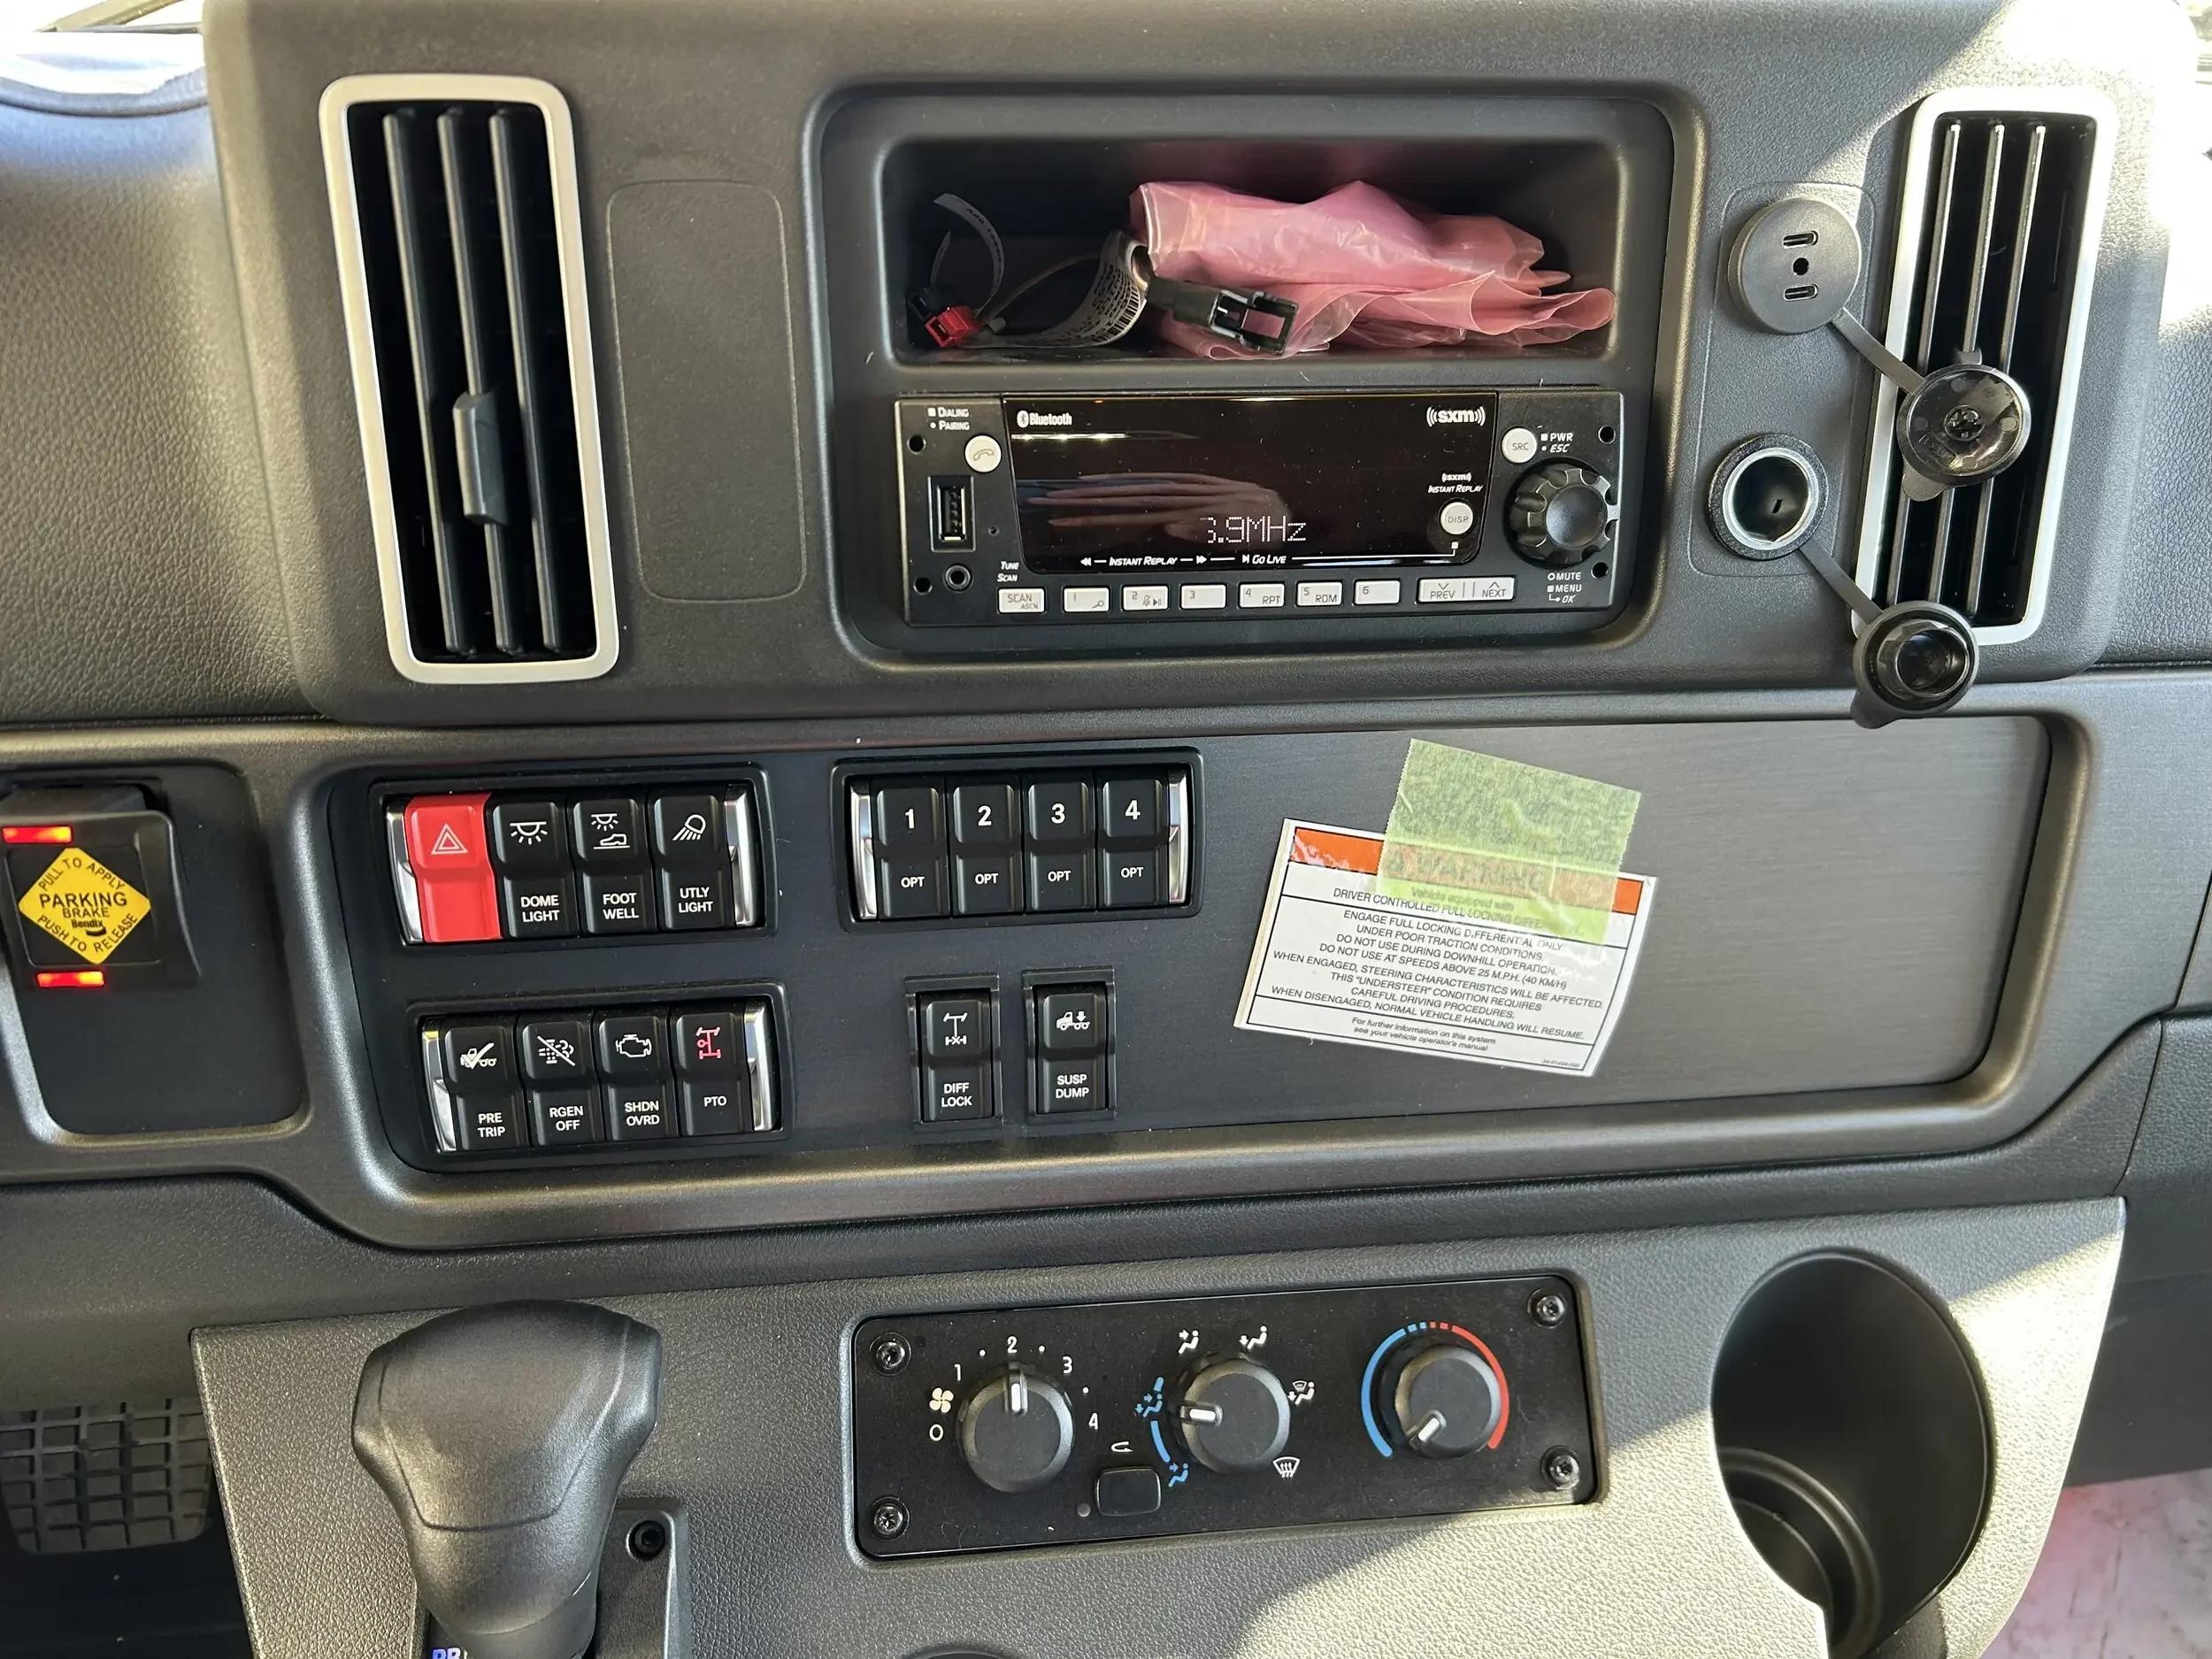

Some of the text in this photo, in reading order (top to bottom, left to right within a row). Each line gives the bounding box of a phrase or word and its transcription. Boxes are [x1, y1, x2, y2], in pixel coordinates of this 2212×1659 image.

[1029, 412, 1072, 426] Bluetooth
[1550, 433, 1573, 442] PWR
[1512, 442, 1528, 451] SRC
[1549, 443, 1569, 453] ESC
[1448, 514, 1469, 525] DISP
[996, 573, 1018, 583] SCAN
[1556, 572, 1581, 581] MUTE
[1189, 590, 1196, 600] 3
[1244, 588, 1252, 597] 4
[1303, 587, 1310, 596] 5
[1362, 586, 1370, 595] 6
[1430, 589, 1455, 600] PREV
[1481, 588, 1507, 599] NEXT
[1555, 583, 1582, 594] MENU
[1007, 594, 1033, 604] SCAN
[1131, 591, 1138, 601] 2
[1262, 595, 1281, 604] RPT
[1315, 593, 1338, 603] RDM
[1562, 595, 1575, 603] OK
[977, 806, 992, 826] 2
[1050, 803, 1065, 825] 3
[1125, 800, 1141, 820] 4
[904, 809, 916, 828] 1
[39, 857, 126, 891] PULL TO APPLY
[974, 872, 999, 885] OPT
[1047, 870, 1071, 883] OPT
[1120, 866, 1144, 879] OPT
[900, 876, 926, 888] OPT
[39, 891, 128, 909] PARKING
[602, 892, 637, 906] FOOT
[679, 887, 710, 901] UTLY
[1333, 888, 1371, 902] DRIVER
[520, 894, 560, 908] DOME
[678, 900, 714, 913] LIGHT
[62, 906, 111, 919] BRAKE
[521, 909, 560, 923] LIGHT
[603, 907, 640, 920] WELL
[71, 918, 104, 929] Bendix
[1344, 910, 1386, 924] ENGAGE
[1389, 917, 1414, 928] FULL
[1417, 921, 1462, 935] LOCKING
[37, 912, 139, 954] PUSH TO RELEASE
[1356, 925, 1393, 937] UNDER
[1395, 931, 1425, 942] POOR
[1428, 936, 1478, 950] TRACTION
[1336, 933, 1352, 943] DO
[1355, 936, 1375, 947] NOT
[1379, 941, 1399, 950] USE
[1402, 944, 1440, 956] DURING
[1444, 950, 1496, 965] DOWNHILL
[1319, 943, 1334, 953] DO
[1337, 946, 1358, 956] NOT
[1361, 949, 1382, 960] USE
[1384, 953, 1396, 962] AT
[1399, 956, 1440, 969] SPEEDS
[1441, 962, 1479, 975] ABOVE
[1479, 968, 1490, 977] 25
[1522, 974, 1537, 984] (40
[1273, 951, 1304, 962] WHEN
[1306, 956, 1359, 972] ENGAGED,
[1361, 965, 1412, 979] STEERING
[1415, 973, 1508, 994] CHARACTERISTICS
[1509, 987, 1532, 998] WILL
[1330, 972, 1353, 982] THIS
[1432, 987, 1488, 1002] CONDITION
[1491, 996, 1541, 1010] REQUIRES
[1351, 987, 1515, 1018] CAREFUL DRIVING PROCEDURES.
[1271, 986, 1302, 997] WHEN
[1304, 991, 1372, 1009] DISENGAGED,
[1375, 1002, 1417, 1015] NORMAL
[1420, 1009, 1462, 1021] VEHICLE
[1463, 1015, 1514, 1029] HANDLING
[1517, 1023, 1539, 1033] WILL
[1367, 1019, 1393, 1028] further
[1395, 1024, 1438, 1035] information
[1468, 1034, 1495, 1044] system
[1458, 1041, 1487, 1050] manual
[1056, 1074, 1087, 1086] SUSP
[943, 1082, 970, 1094] DIFF
[1055, 1087, 1090, 1099] DUMP
[624, 1101, 660, 1113] SHDN
[703, 1095, 728, 1108] PTO
[941, 1095, 973, 1108] LOCK
[478, 1112, 503, 1125] PRE
[549, 1106, 584, 1118] RGEN
[556, 1118, 580, 1132] OFF
[626, 1114, 661, 1126] OVRD
[477, 1125, 506, 1139] TRIP
[1007, 1336, 1018, 1354] 2
[1062, 1356, 1073, 1374] 3
[954, 1363, 962, 1381] 1
[1088, 1412, 1099, 1430] 4
